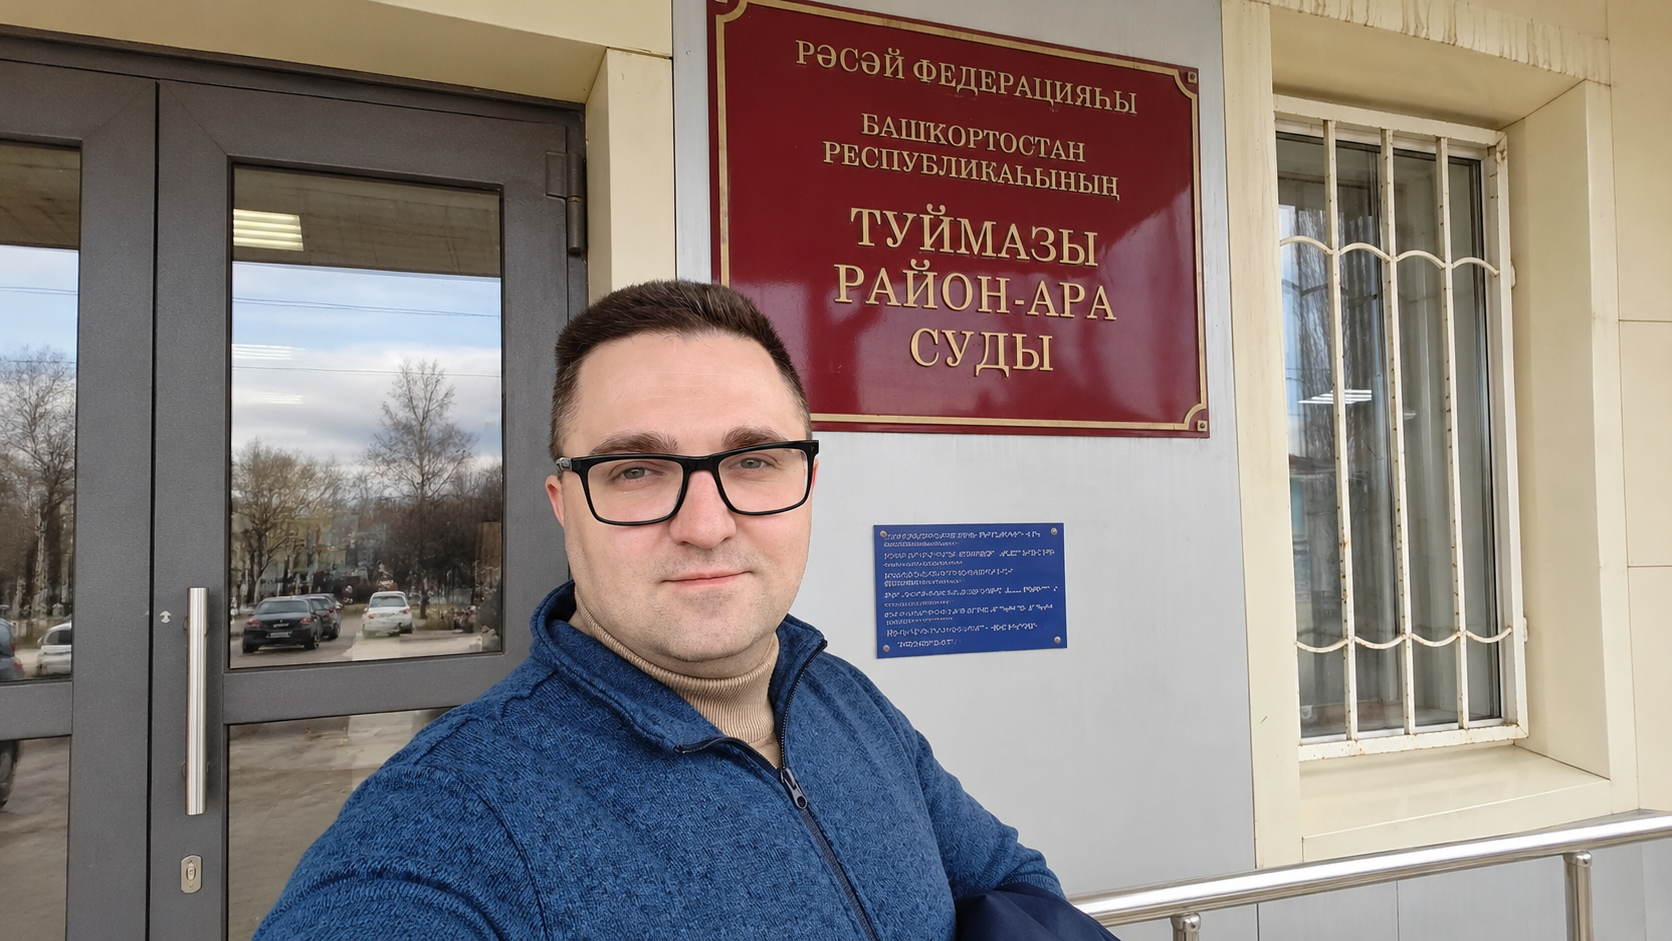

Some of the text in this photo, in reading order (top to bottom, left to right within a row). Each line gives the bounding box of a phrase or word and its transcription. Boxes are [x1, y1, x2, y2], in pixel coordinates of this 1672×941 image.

[796, 40, 1137, 114] РӘСӘЙ ФЕДЕРАЦИЯҺЫ
[861, 113, 1085, 163] БАШҠОРТОСТАН
[823, 141, 1120, 201] РЕСПУБЛИКАҺЫНЫҢ
[850, 203, 1099, 267] ТУЙМАЗЫ
[834, 258, 1117, 321] РАЙОН-АРА
[910, 327, 1054, 378] СУДЫ
